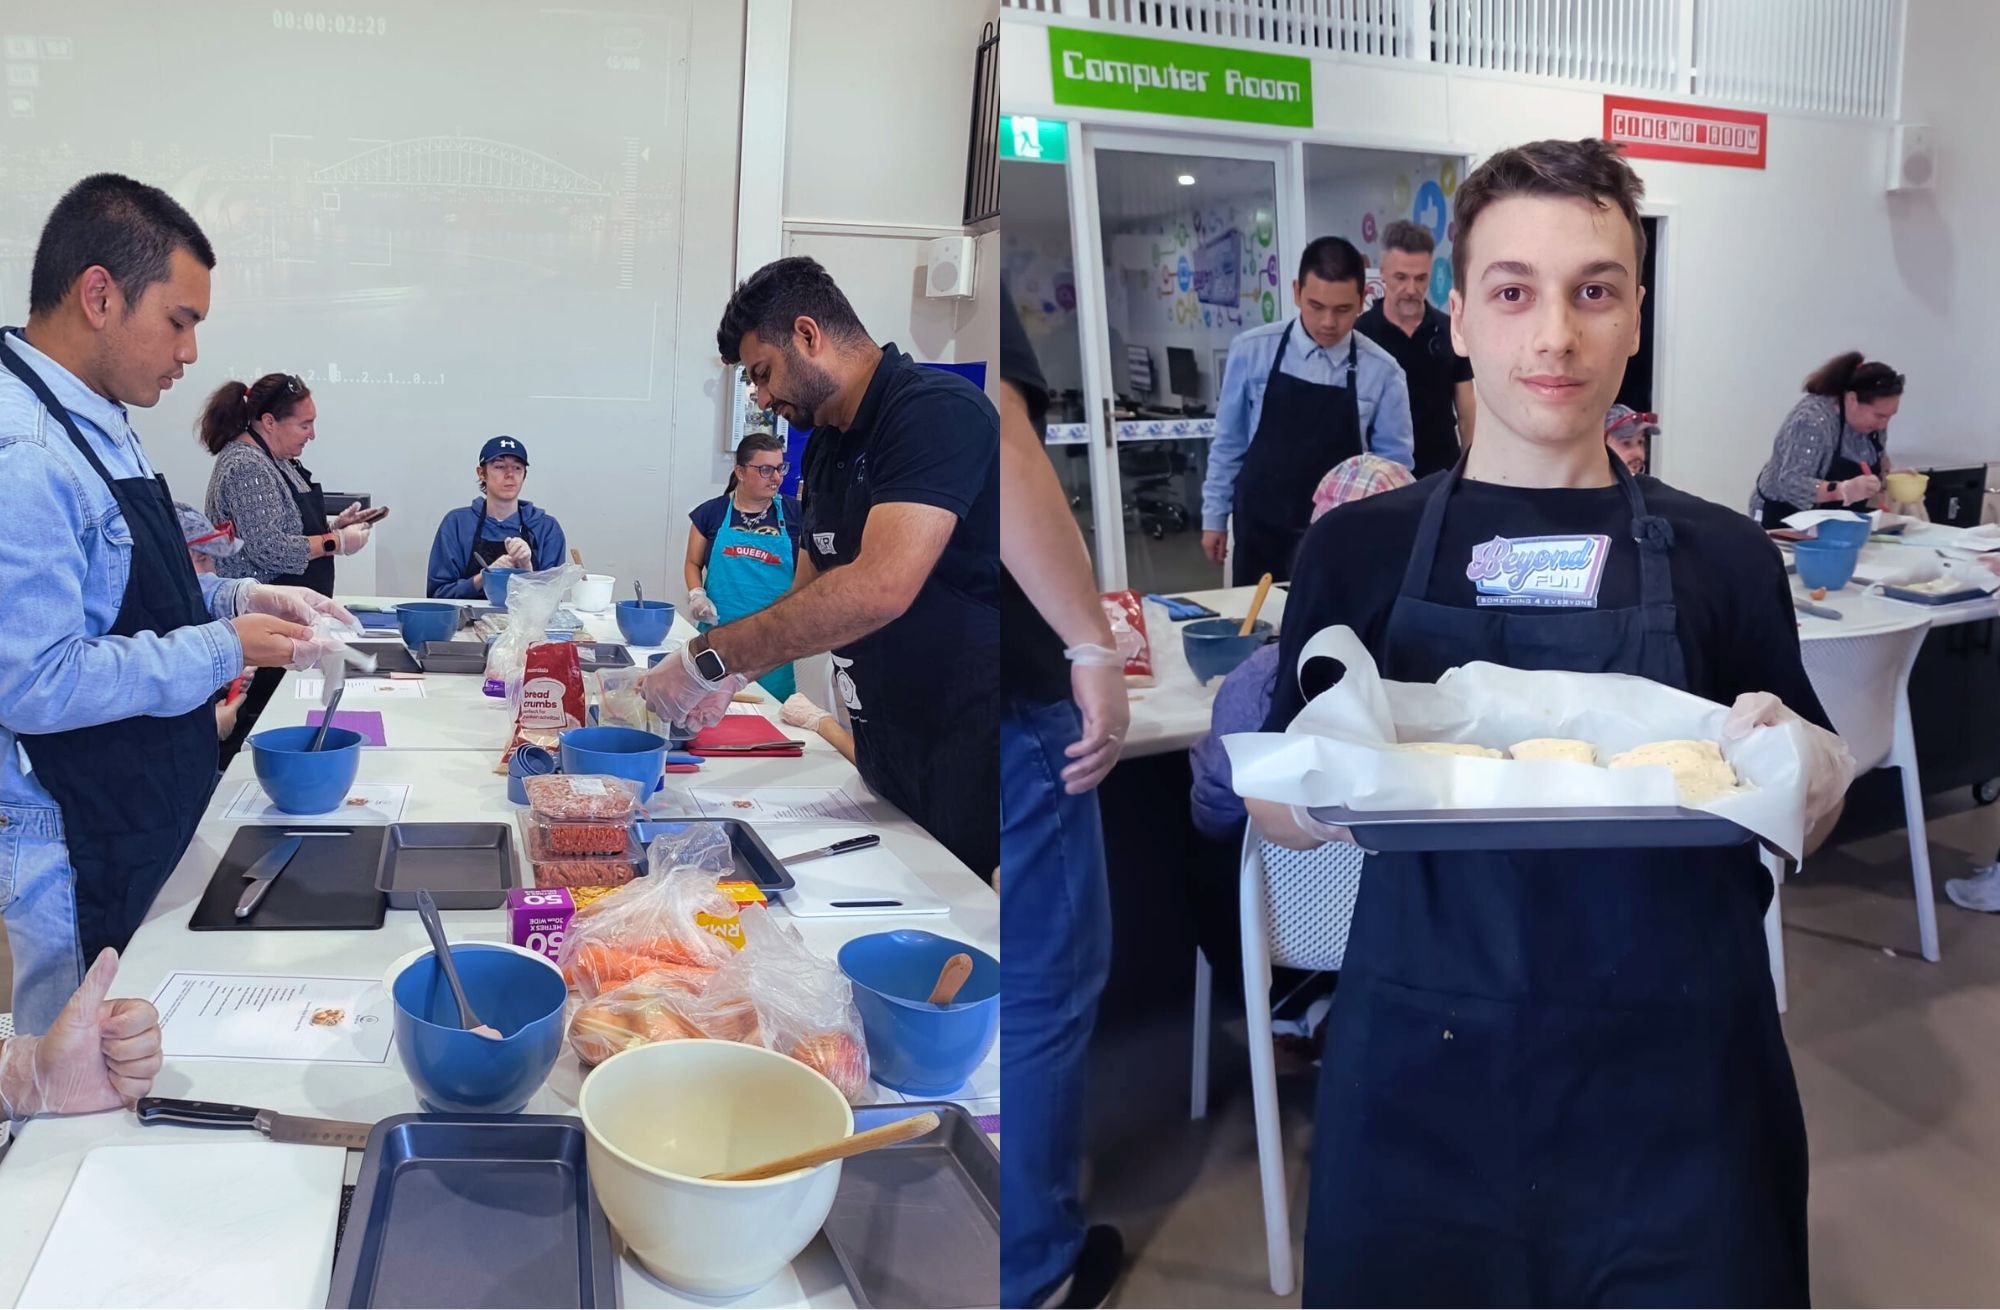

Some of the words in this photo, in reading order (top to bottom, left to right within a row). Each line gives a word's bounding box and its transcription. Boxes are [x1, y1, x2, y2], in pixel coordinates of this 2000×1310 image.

[1062, 50, 1211, 93] Computer
[1225, 69, 1301, 102] Room
[1614, 114, 1694, 142] CINEMA
[1710, 125, 1759, 149] ROOM
[736, 546, 769, 560] QUEEN
[1466, 535, 1595, 592] Beyond
[1535, 575, 1579, 588] FUN
[1544, 598, 1593, 606] EVERYONE
[524, 690, 550, 699] bread
[523, 700, 558, 708] crumbs
[523, 895, 563, 905] 50
[525, 931, 564, 956] 50
